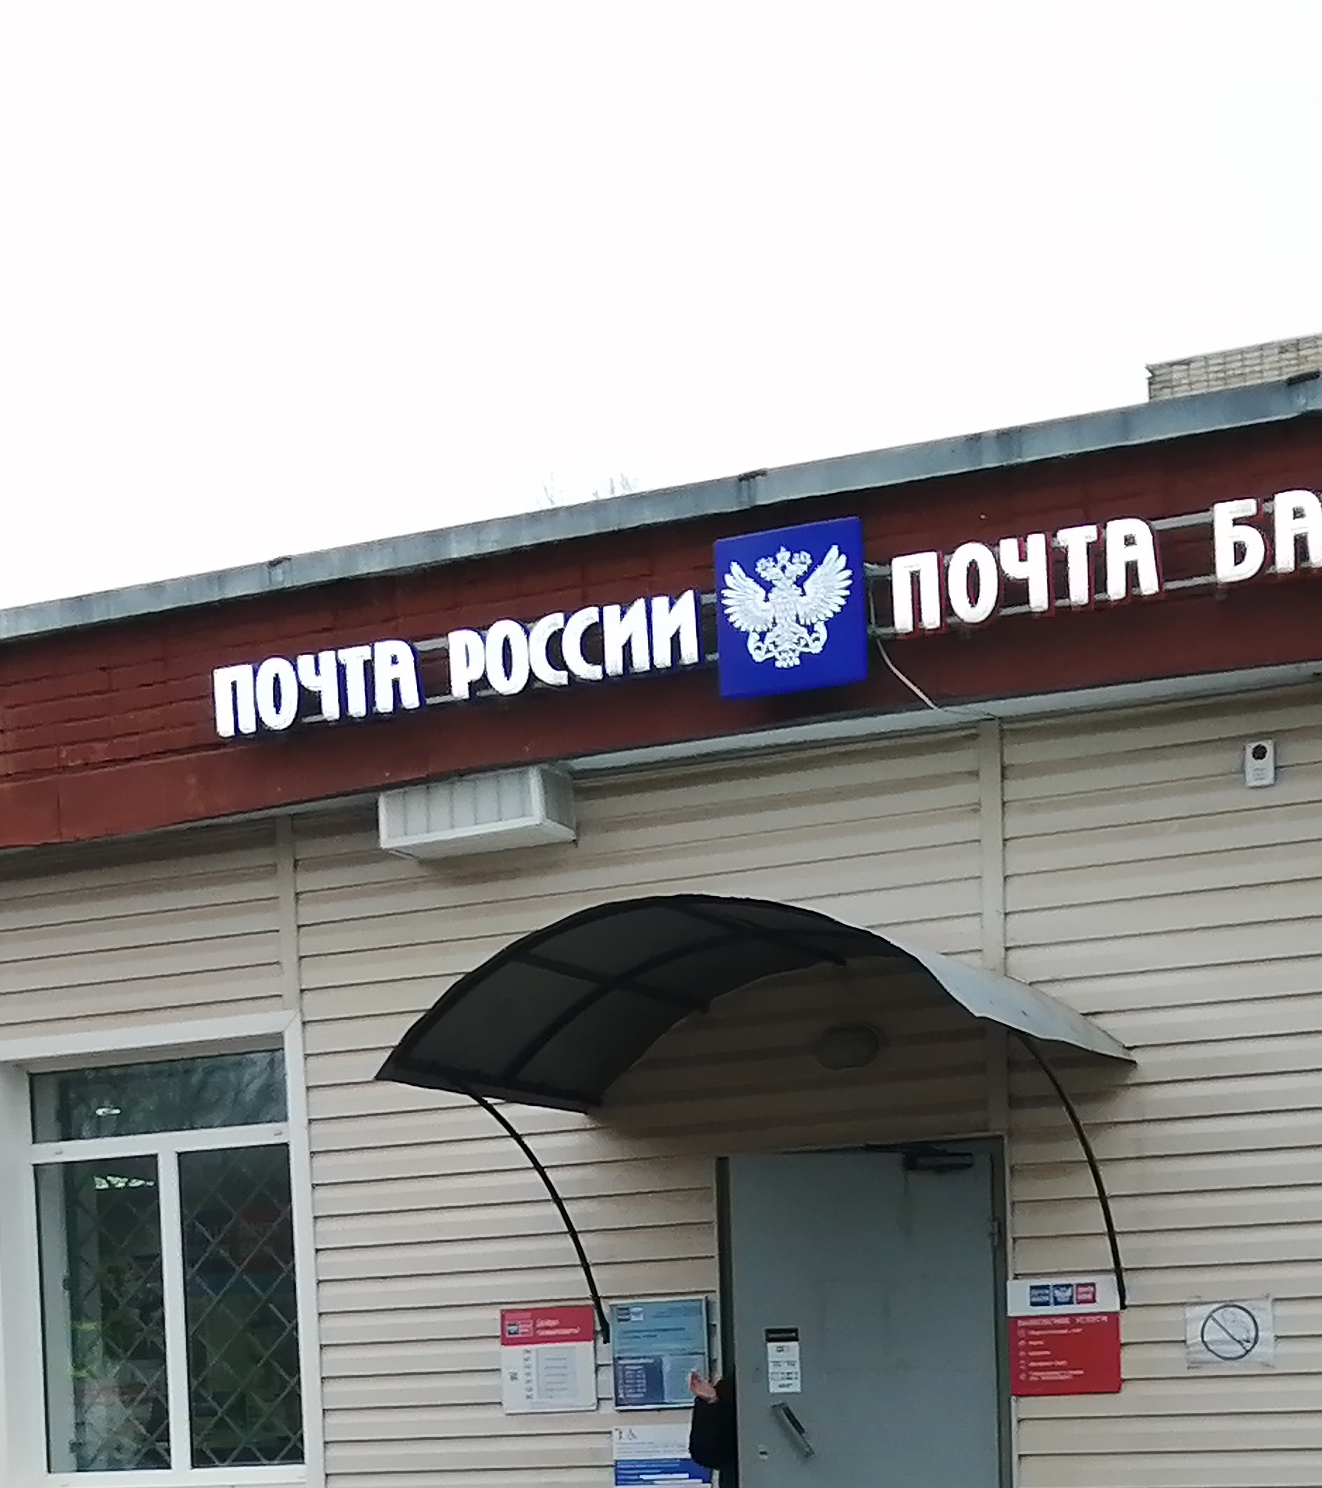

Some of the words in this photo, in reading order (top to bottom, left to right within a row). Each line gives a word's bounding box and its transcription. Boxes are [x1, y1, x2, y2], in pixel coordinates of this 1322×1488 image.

[890, 517, 1161, 634] ПОЧТА
[212, 638, 421, 739] ПОЧТА
[448, 588, 702, 700] РОССИИ
